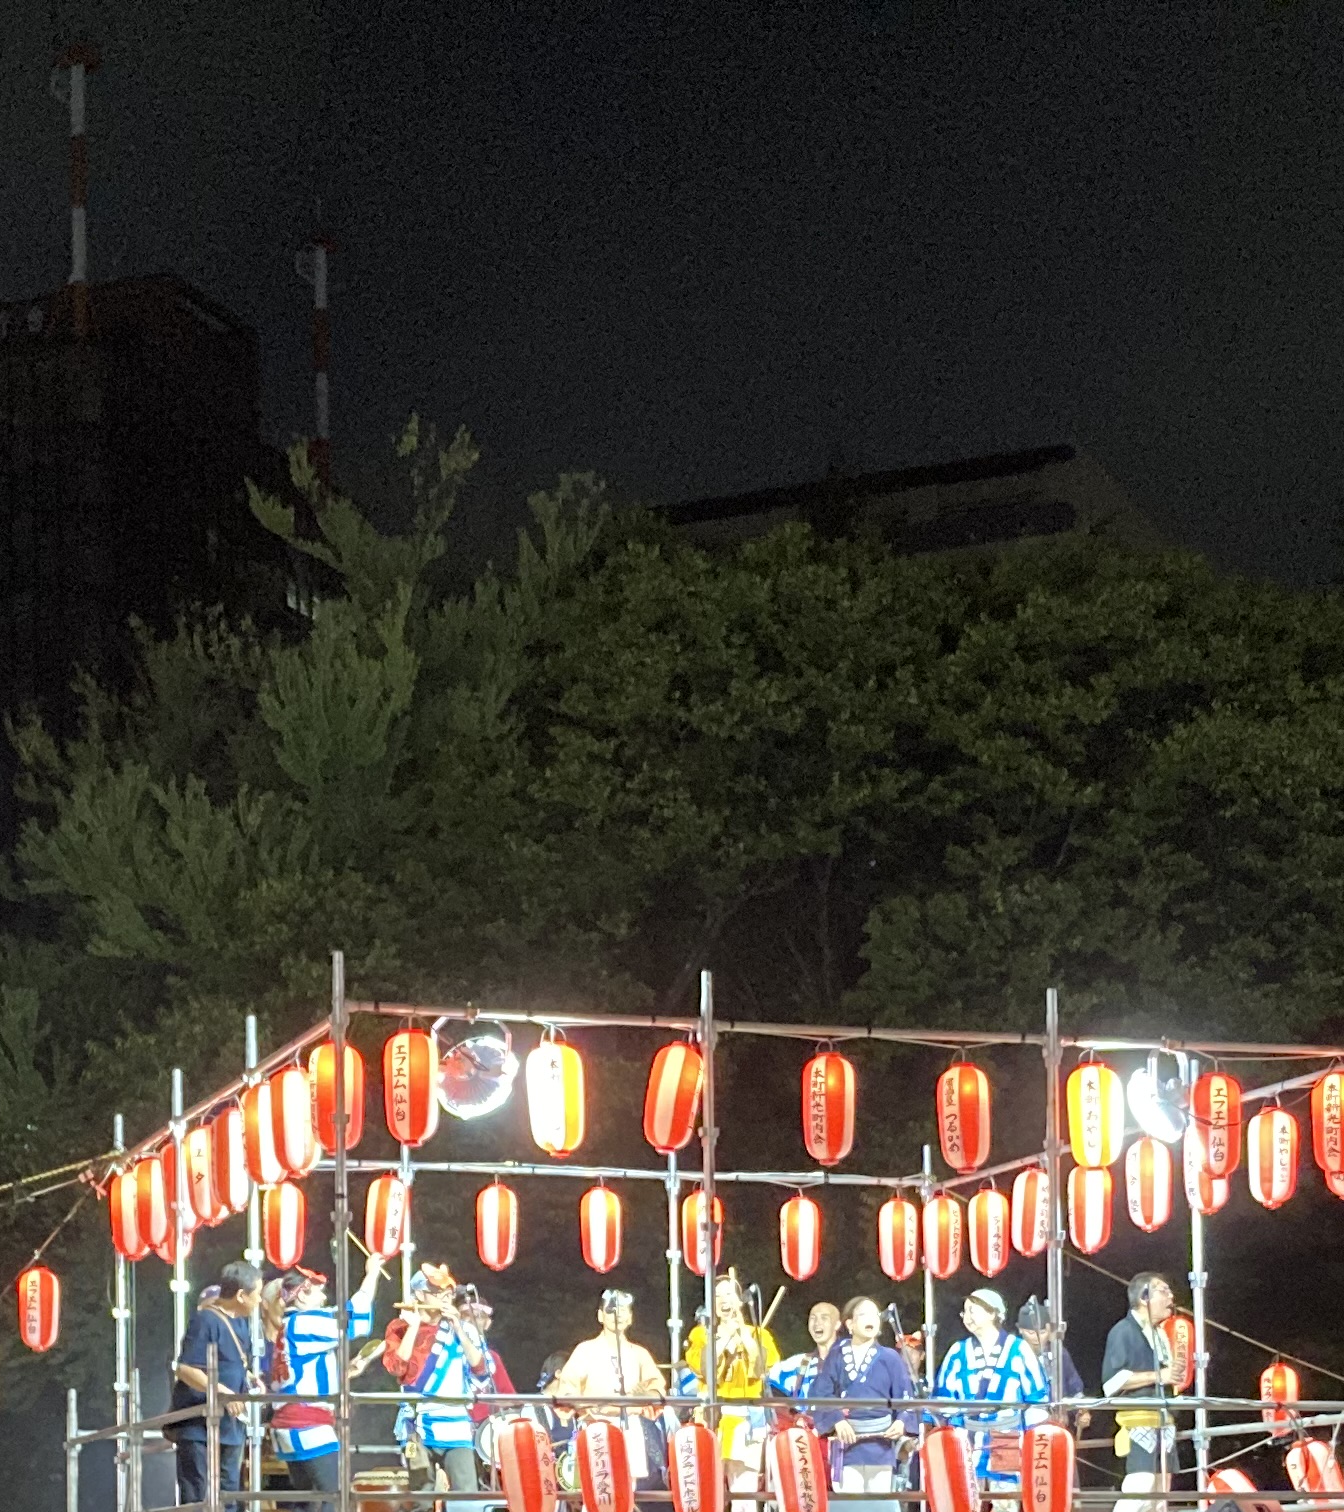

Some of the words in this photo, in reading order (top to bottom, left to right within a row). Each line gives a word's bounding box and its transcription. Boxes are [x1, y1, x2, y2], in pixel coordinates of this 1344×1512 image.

[394, 1044, 407, 1121] エフエム仙台
[1212, 1087, 1228, 1162] エフエム仙台
[1034, 1434, 1049, 1503] エフエム仙台
